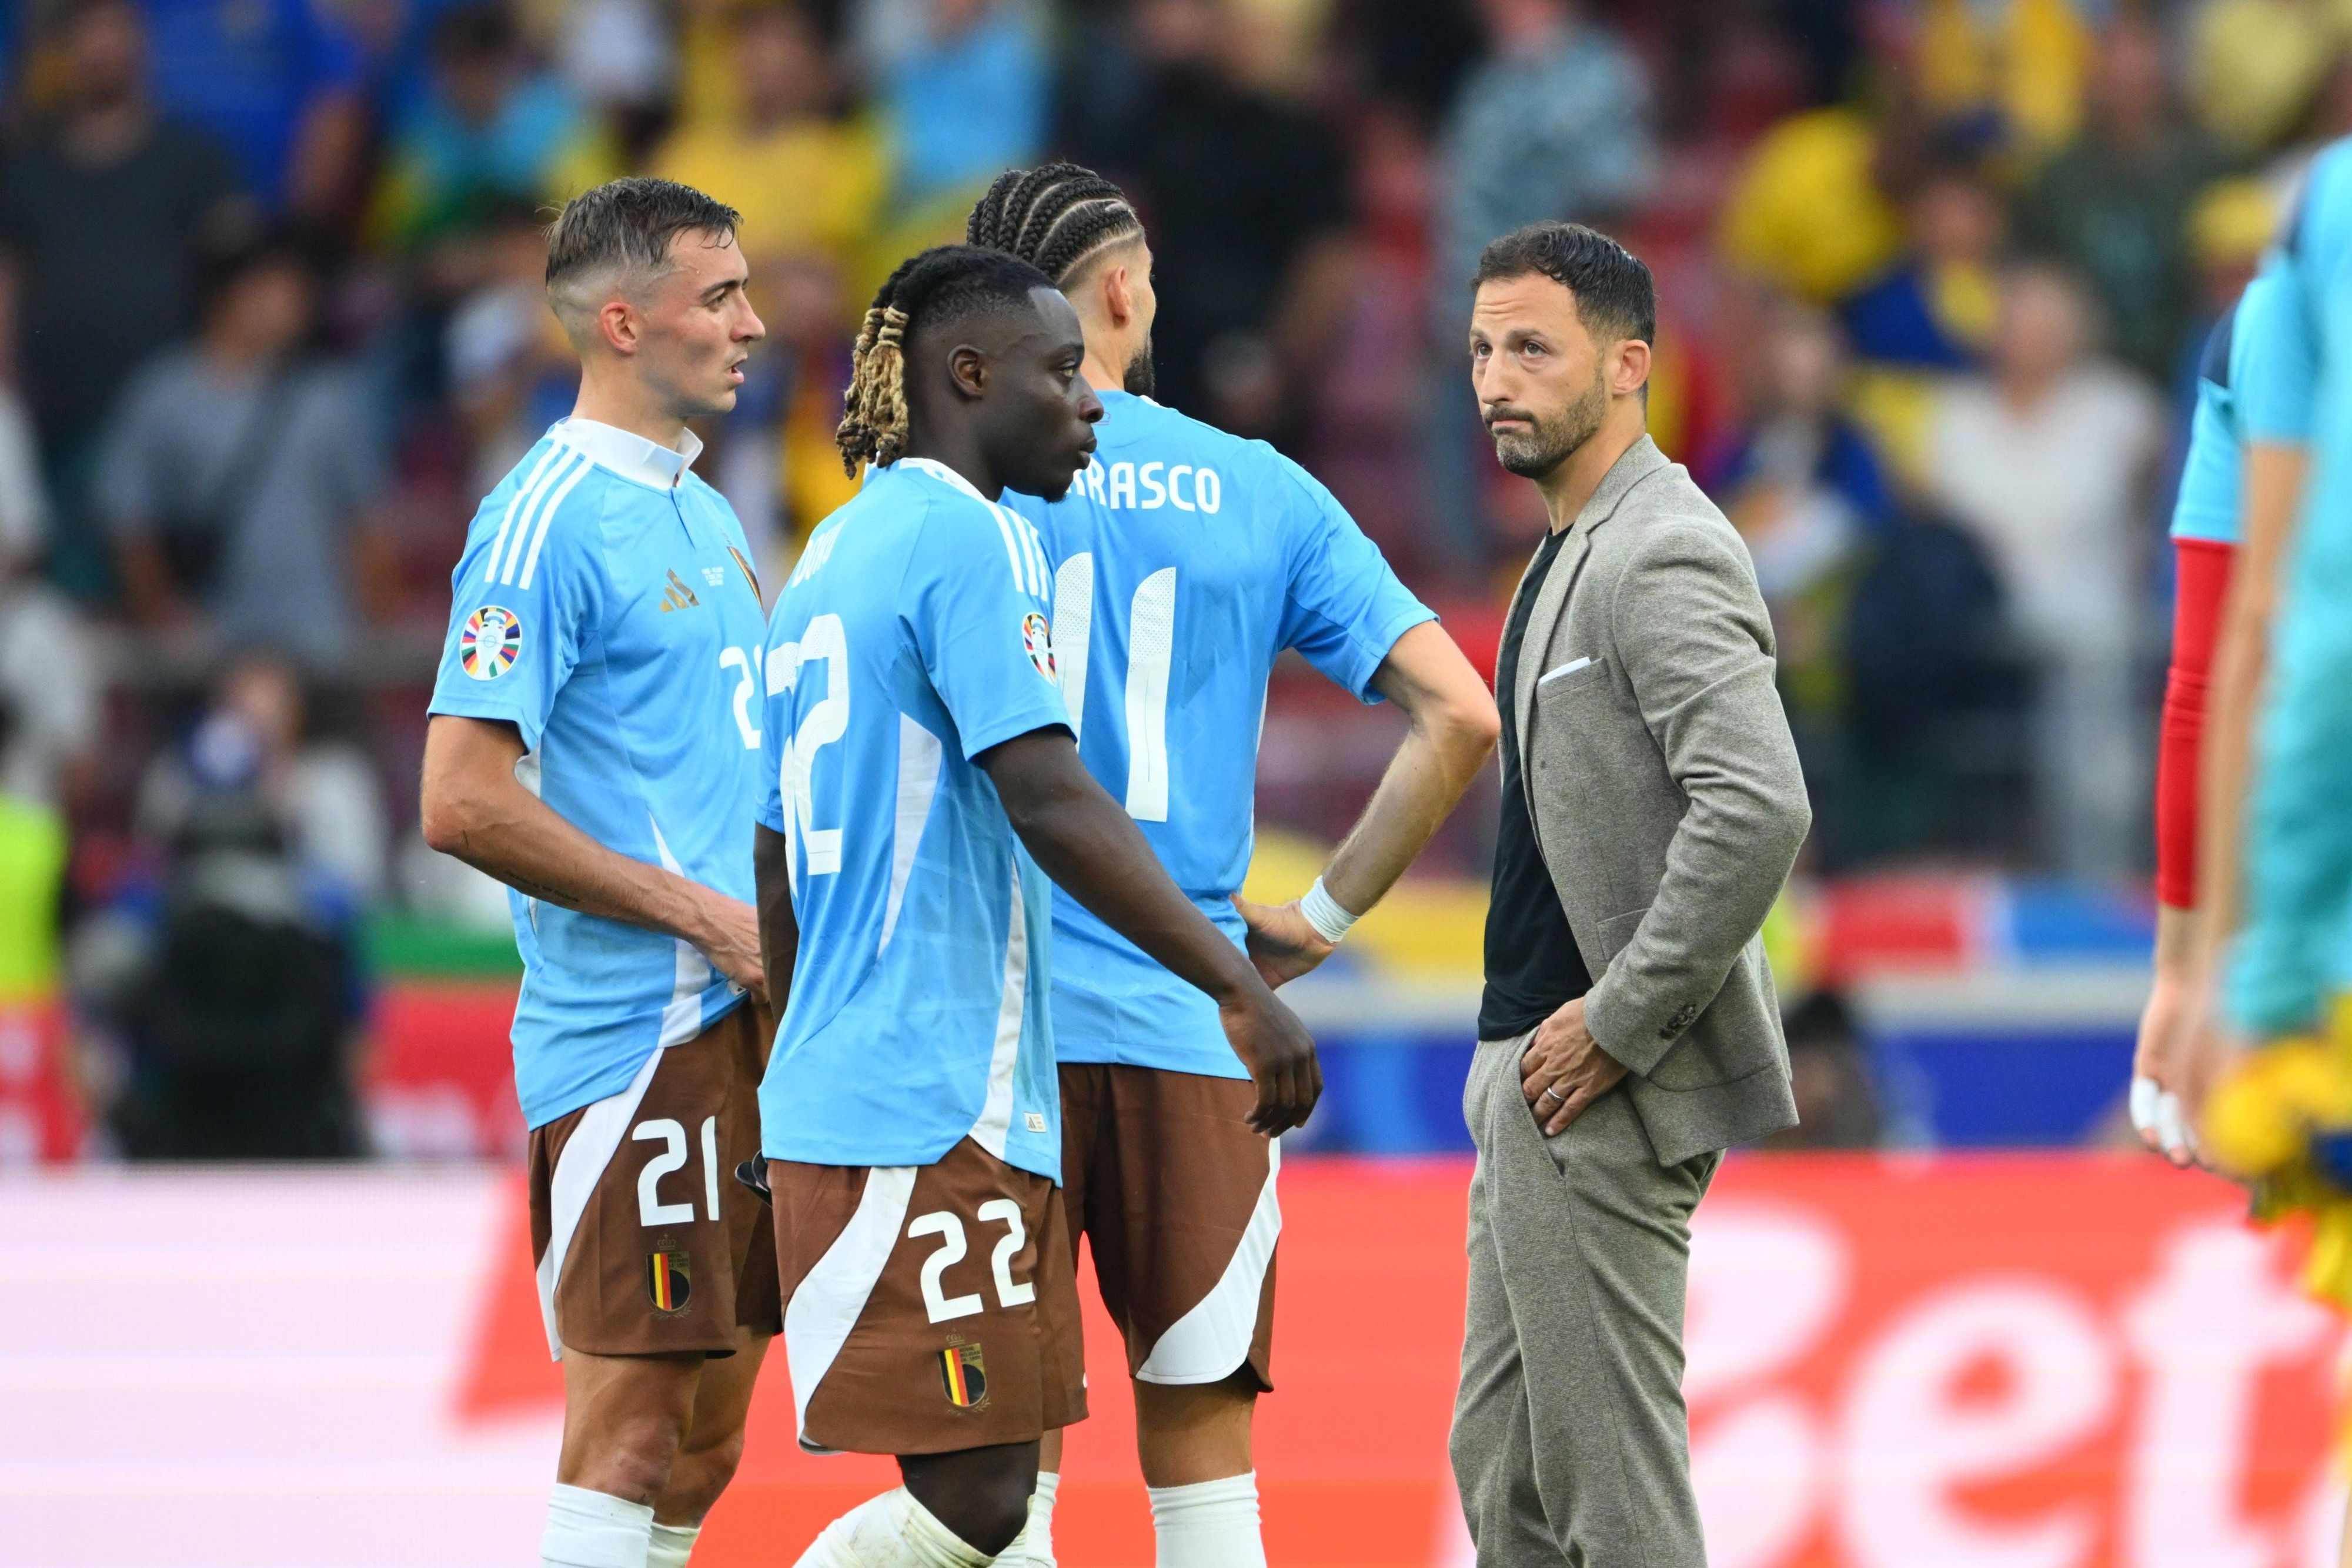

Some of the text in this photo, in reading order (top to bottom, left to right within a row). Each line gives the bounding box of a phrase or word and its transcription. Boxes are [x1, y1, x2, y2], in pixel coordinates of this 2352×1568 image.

[719, 645, 763, 750] 2
[1051, 551, 1176, 823] 11
[632, 1115, 720, 1227] 21
[907, 1199, 1036, 1324] 22
[1529, 1196, 2352, 1568] Bet
